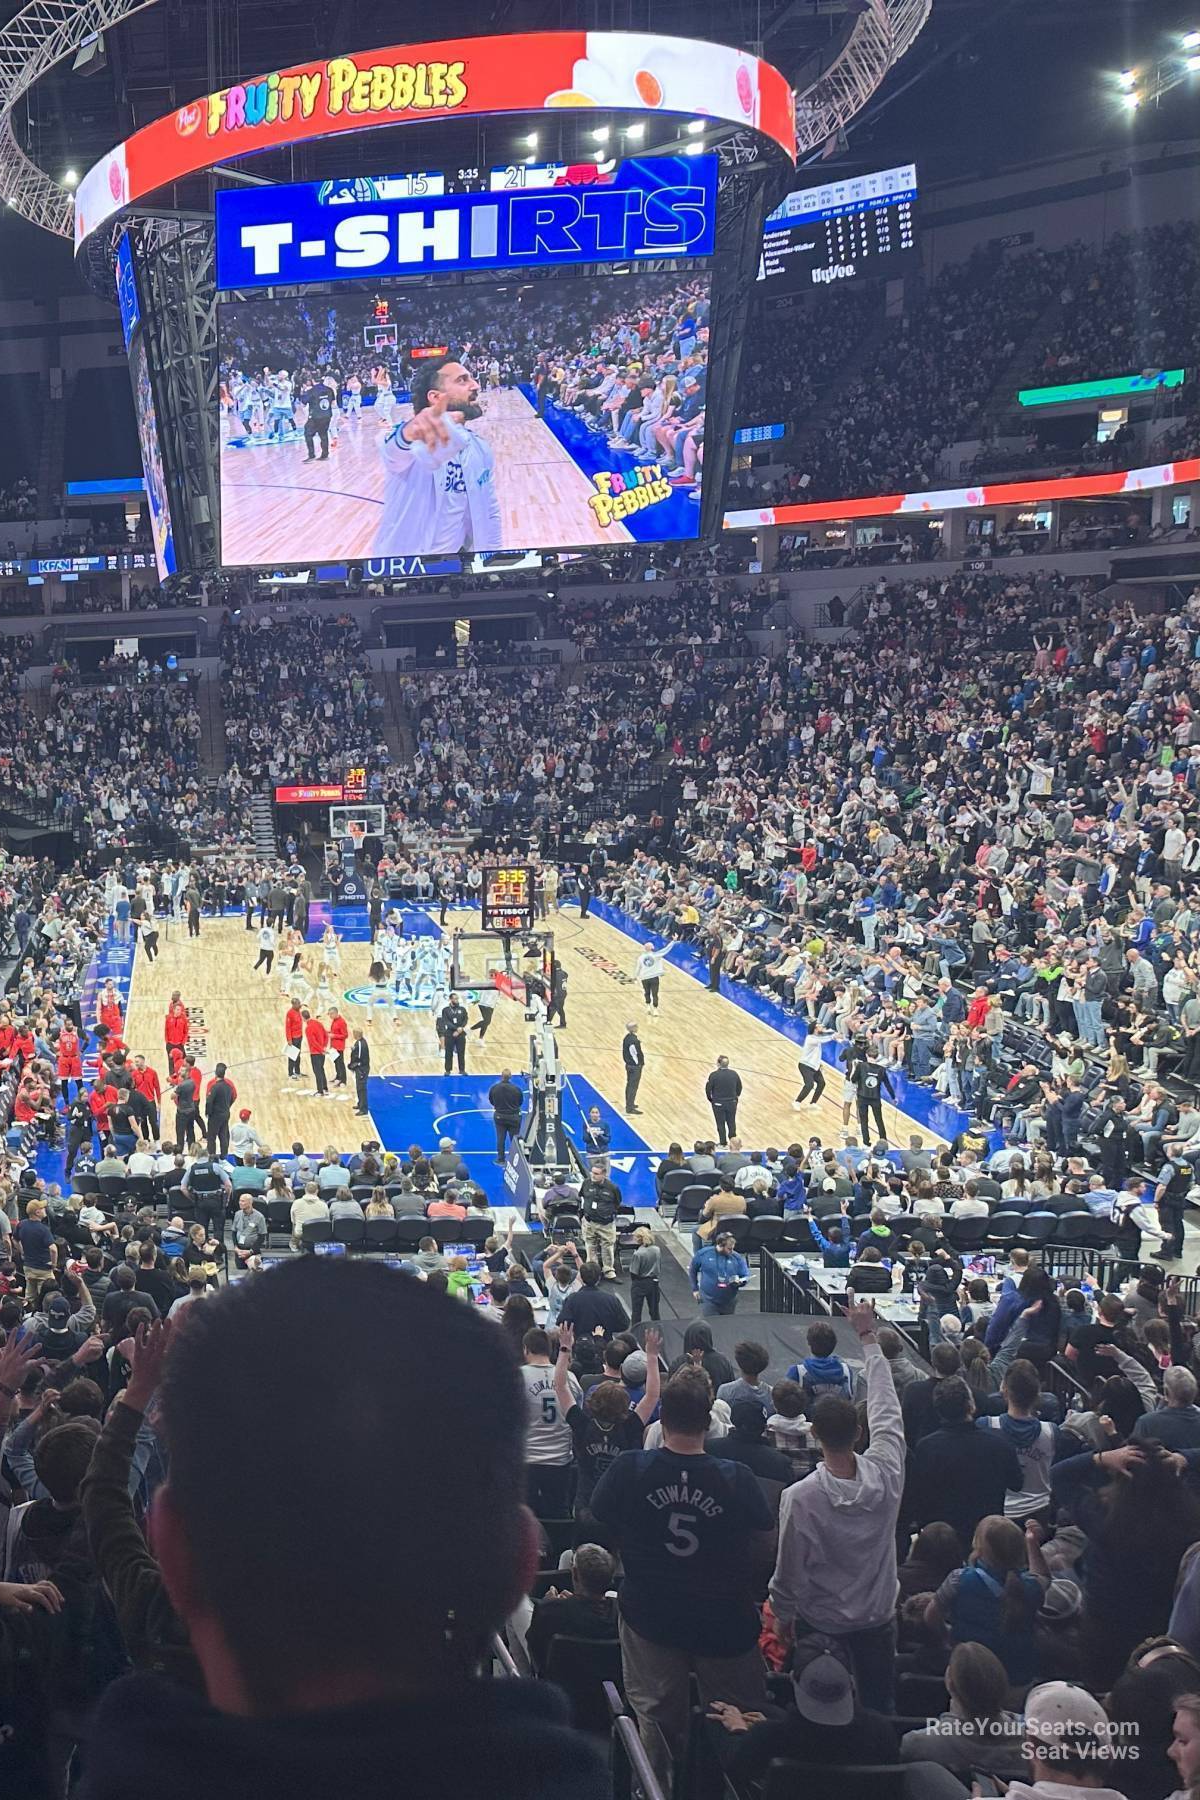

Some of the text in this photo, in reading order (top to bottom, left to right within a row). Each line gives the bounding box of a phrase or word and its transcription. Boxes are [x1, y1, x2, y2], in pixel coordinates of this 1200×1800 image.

[207, 72, 322, 137] FRUITY
[325, 57, 469, 116] PEBBLES
[458, 168, 479, 180] 3:35
[504, 166, 527, 188] 21
[548, 170, 555, 178] 2
[406, 173, 429, 196] 15
[241, 187, 706, 275] T-SHIRTS
[763, 230, 791, 240] Anderson
[763, 239, 789, 249] Edwards
[765, 258, 779, 266] Reid
[588, 464, 673, 527] FRUITY PEBBLES
[5, 561, 13, 569] 14
[38, 558, 72, 573] KFAN
[347, 775, 364, 788] 24
[498, 870, 527, 883] 3:35
[491, 883, 523, 905] 24
[542, 1397, 556, 1424] 5
[646, 1484, 723, 1518] EDWARDS
[665, 1511, 699, 1557] 5
